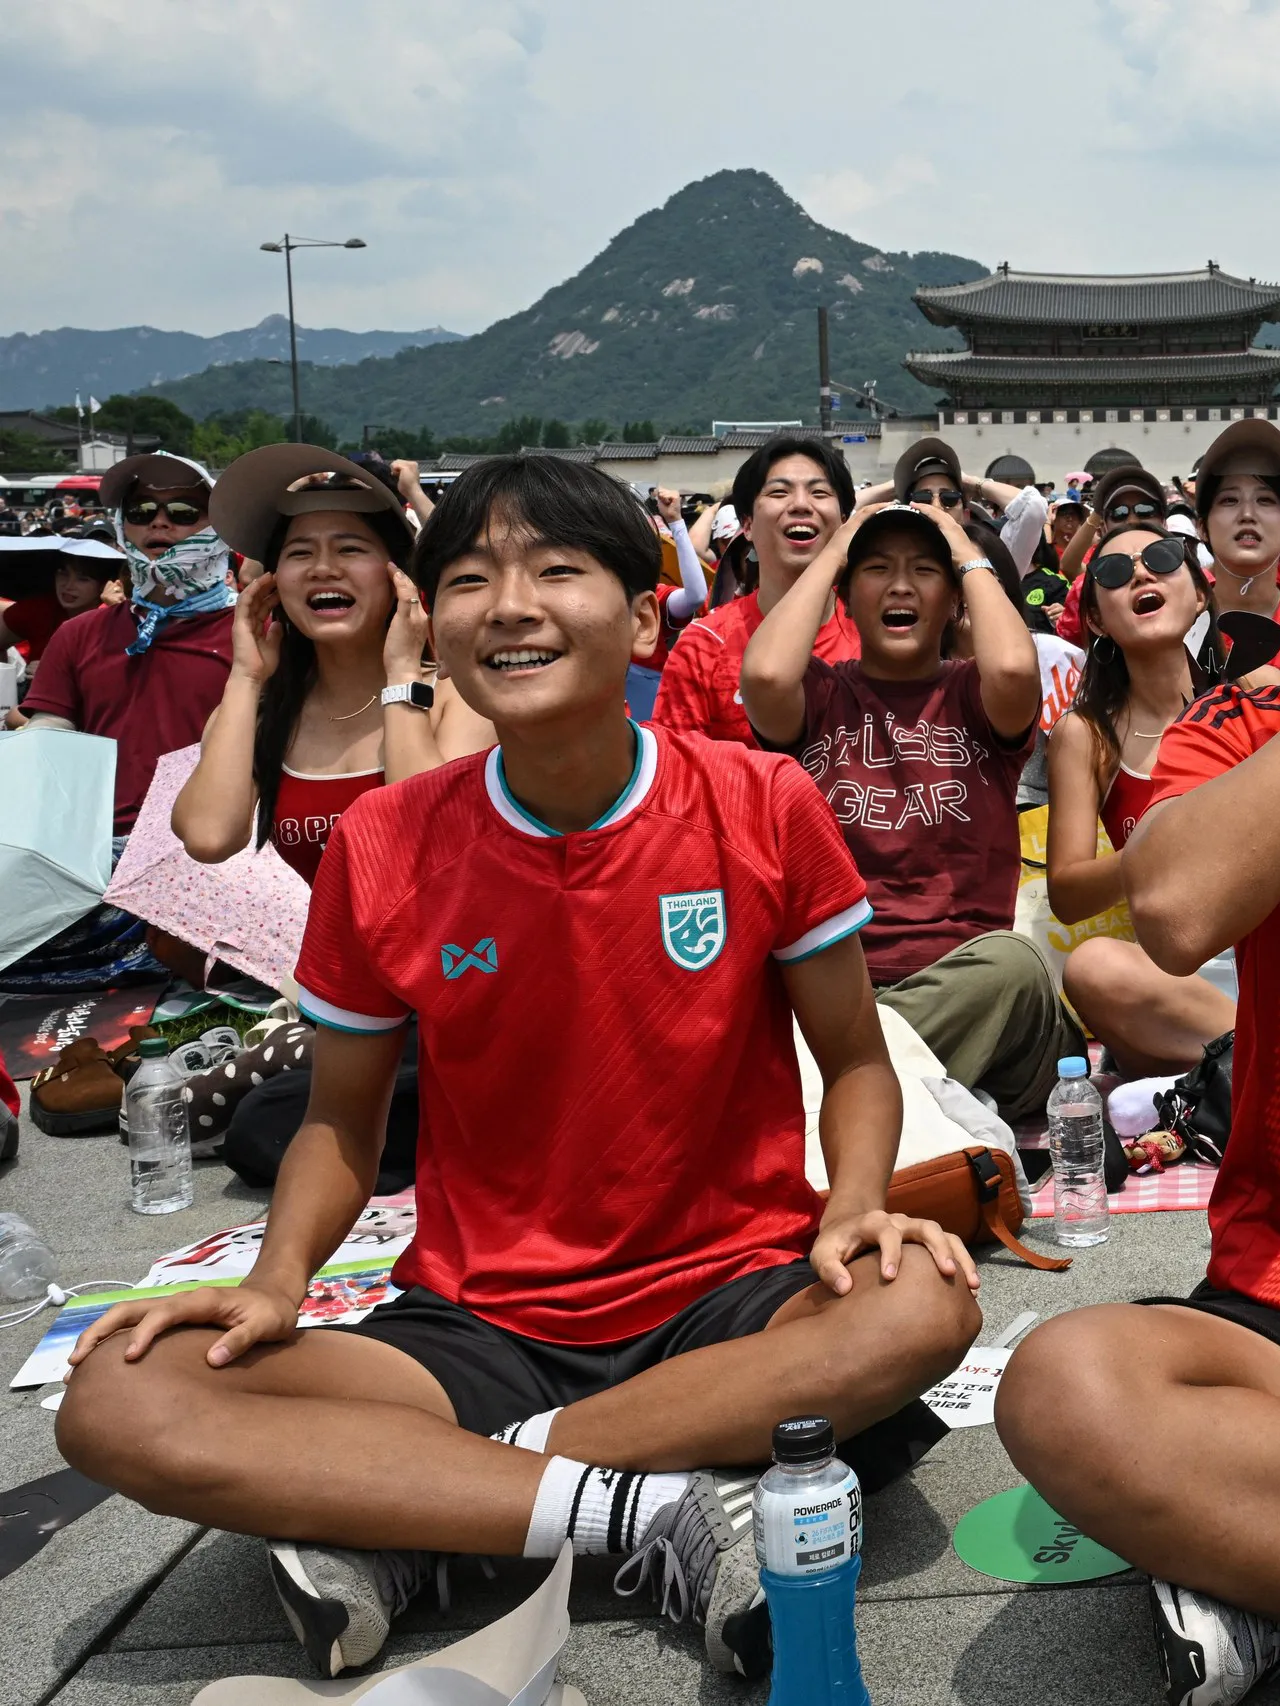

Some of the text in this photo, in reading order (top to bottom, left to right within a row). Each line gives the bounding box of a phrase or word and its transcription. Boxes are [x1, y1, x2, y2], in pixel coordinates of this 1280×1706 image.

[827, 779, 971, 830] GEAR
[667, 897, 717, 910] THAILAND
[923, 1399, 972, 1410] 퀄리티
[793, 1497, 843, 1517] POWERADE
[799, 1516, 824, 1524] ZERO
